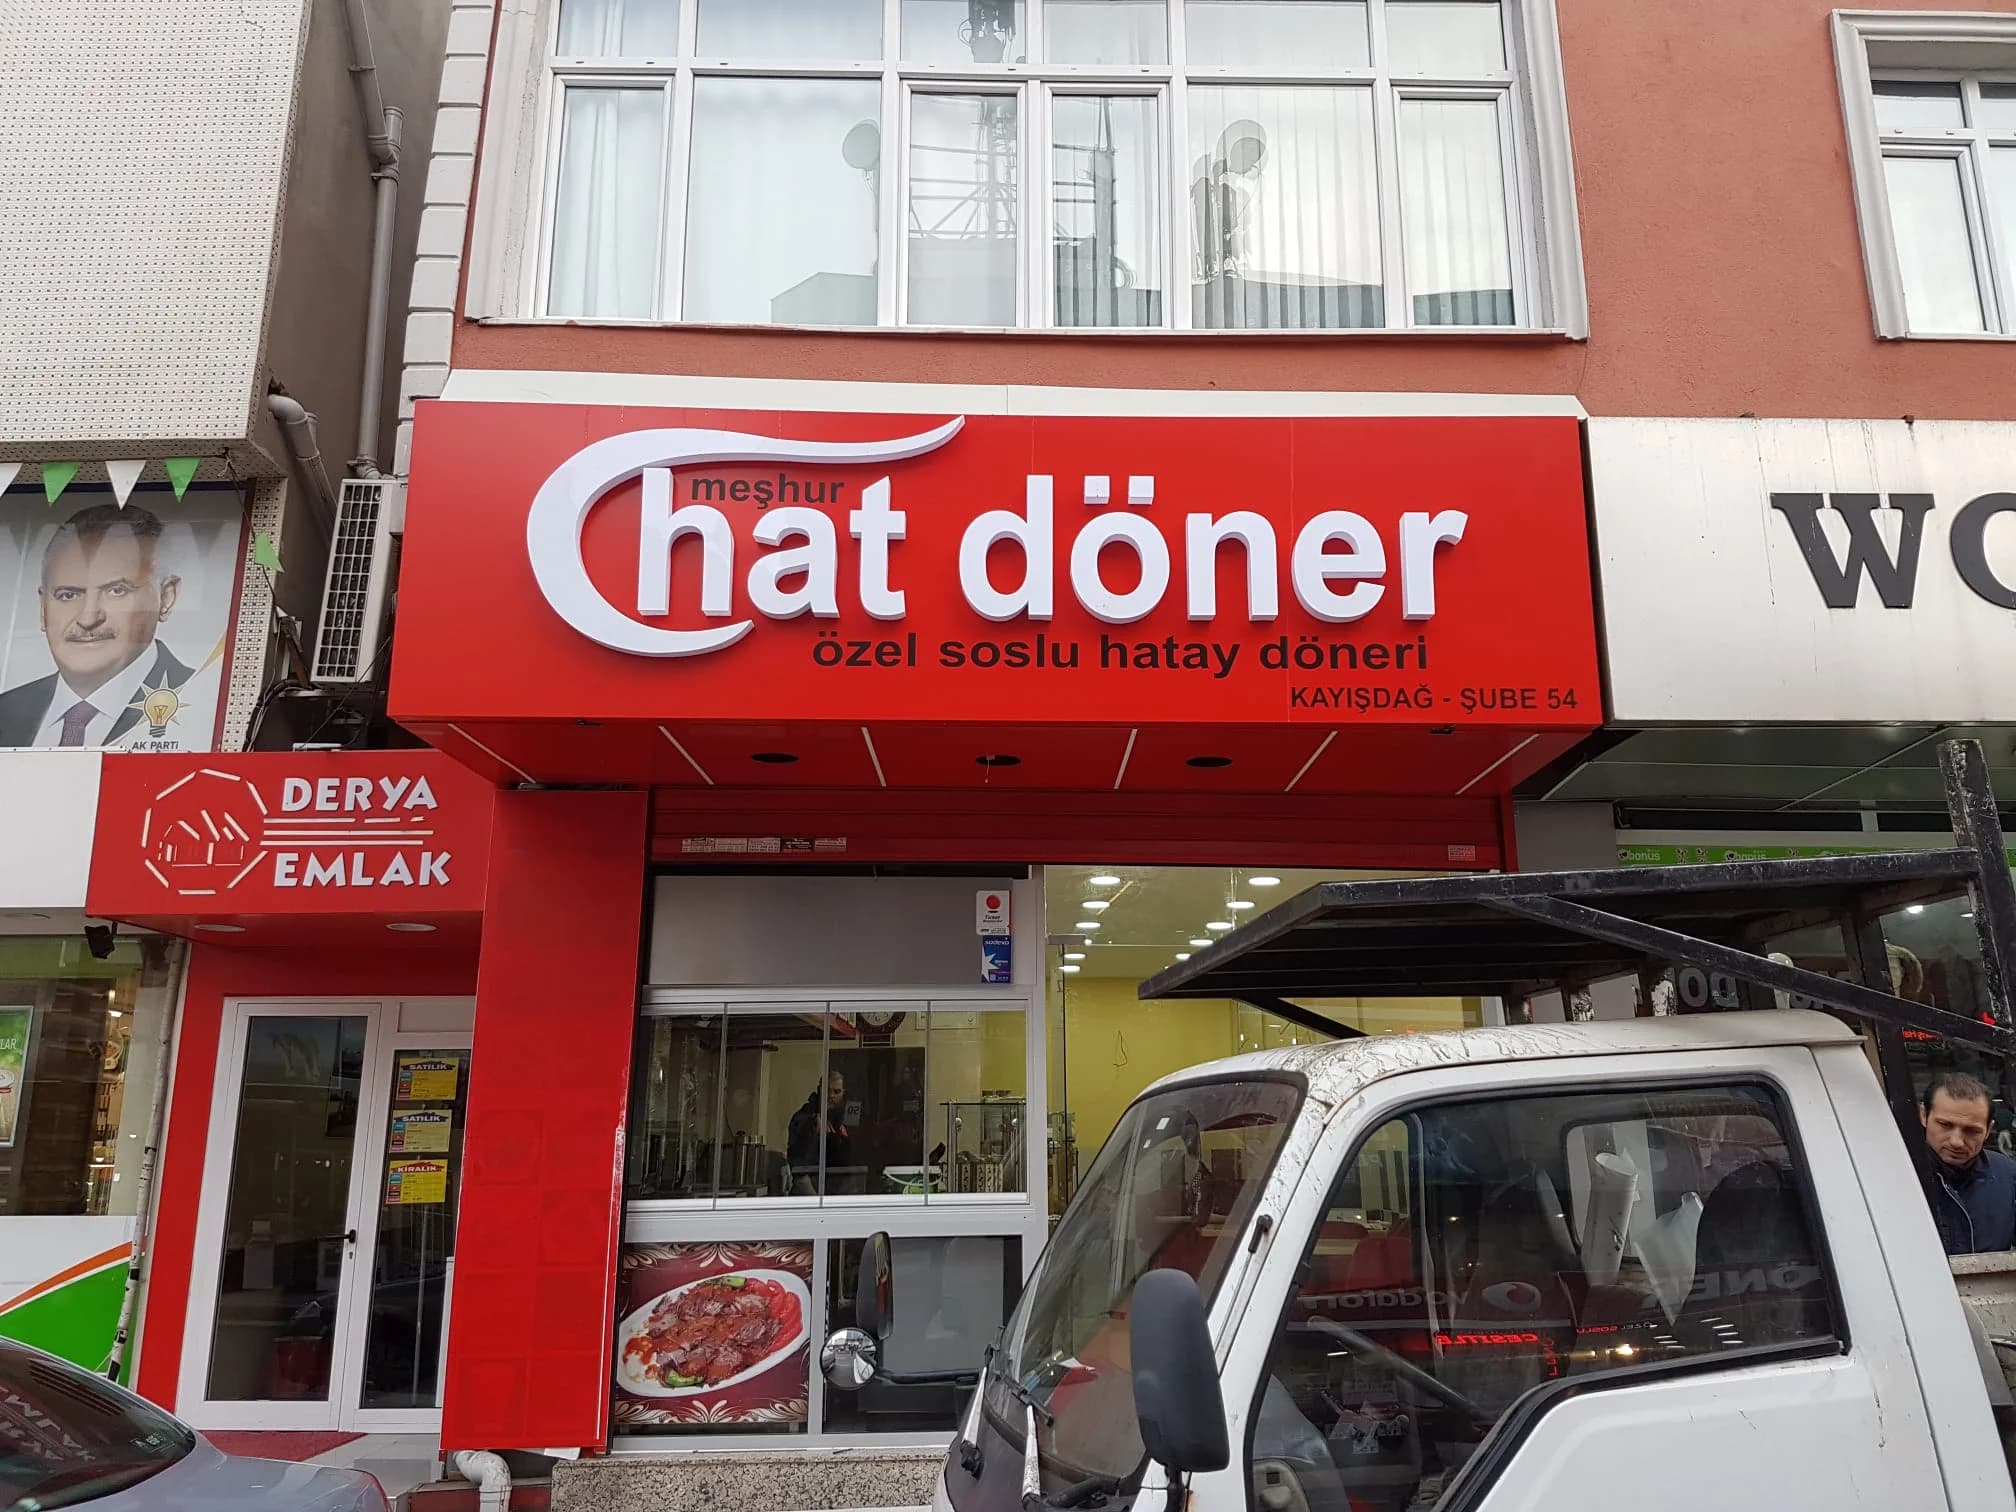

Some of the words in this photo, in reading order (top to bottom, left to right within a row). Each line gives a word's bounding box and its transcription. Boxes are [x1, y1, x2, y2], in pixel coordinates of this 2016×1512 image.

[690, 473, 845, 510] meşhur
[958, 474, 1469, 624] döner
[812, 630, 917, 667] özel
[939, 633, 1079, 668] soslu
[1100, 633, 1241, 679] hatay
[1259, 634, 1427, 669] döneri
[1290, 684, 1434, 713] KAYIŞDAĞ
[1460, 687, 1537, 713] ŞUBE
[1547, 688, 1578, 710] 54
[131, 741, 147, 750] AK
[281, 776, 438, 812] DERYA
[273, 851, 451, 888] EMLAK
